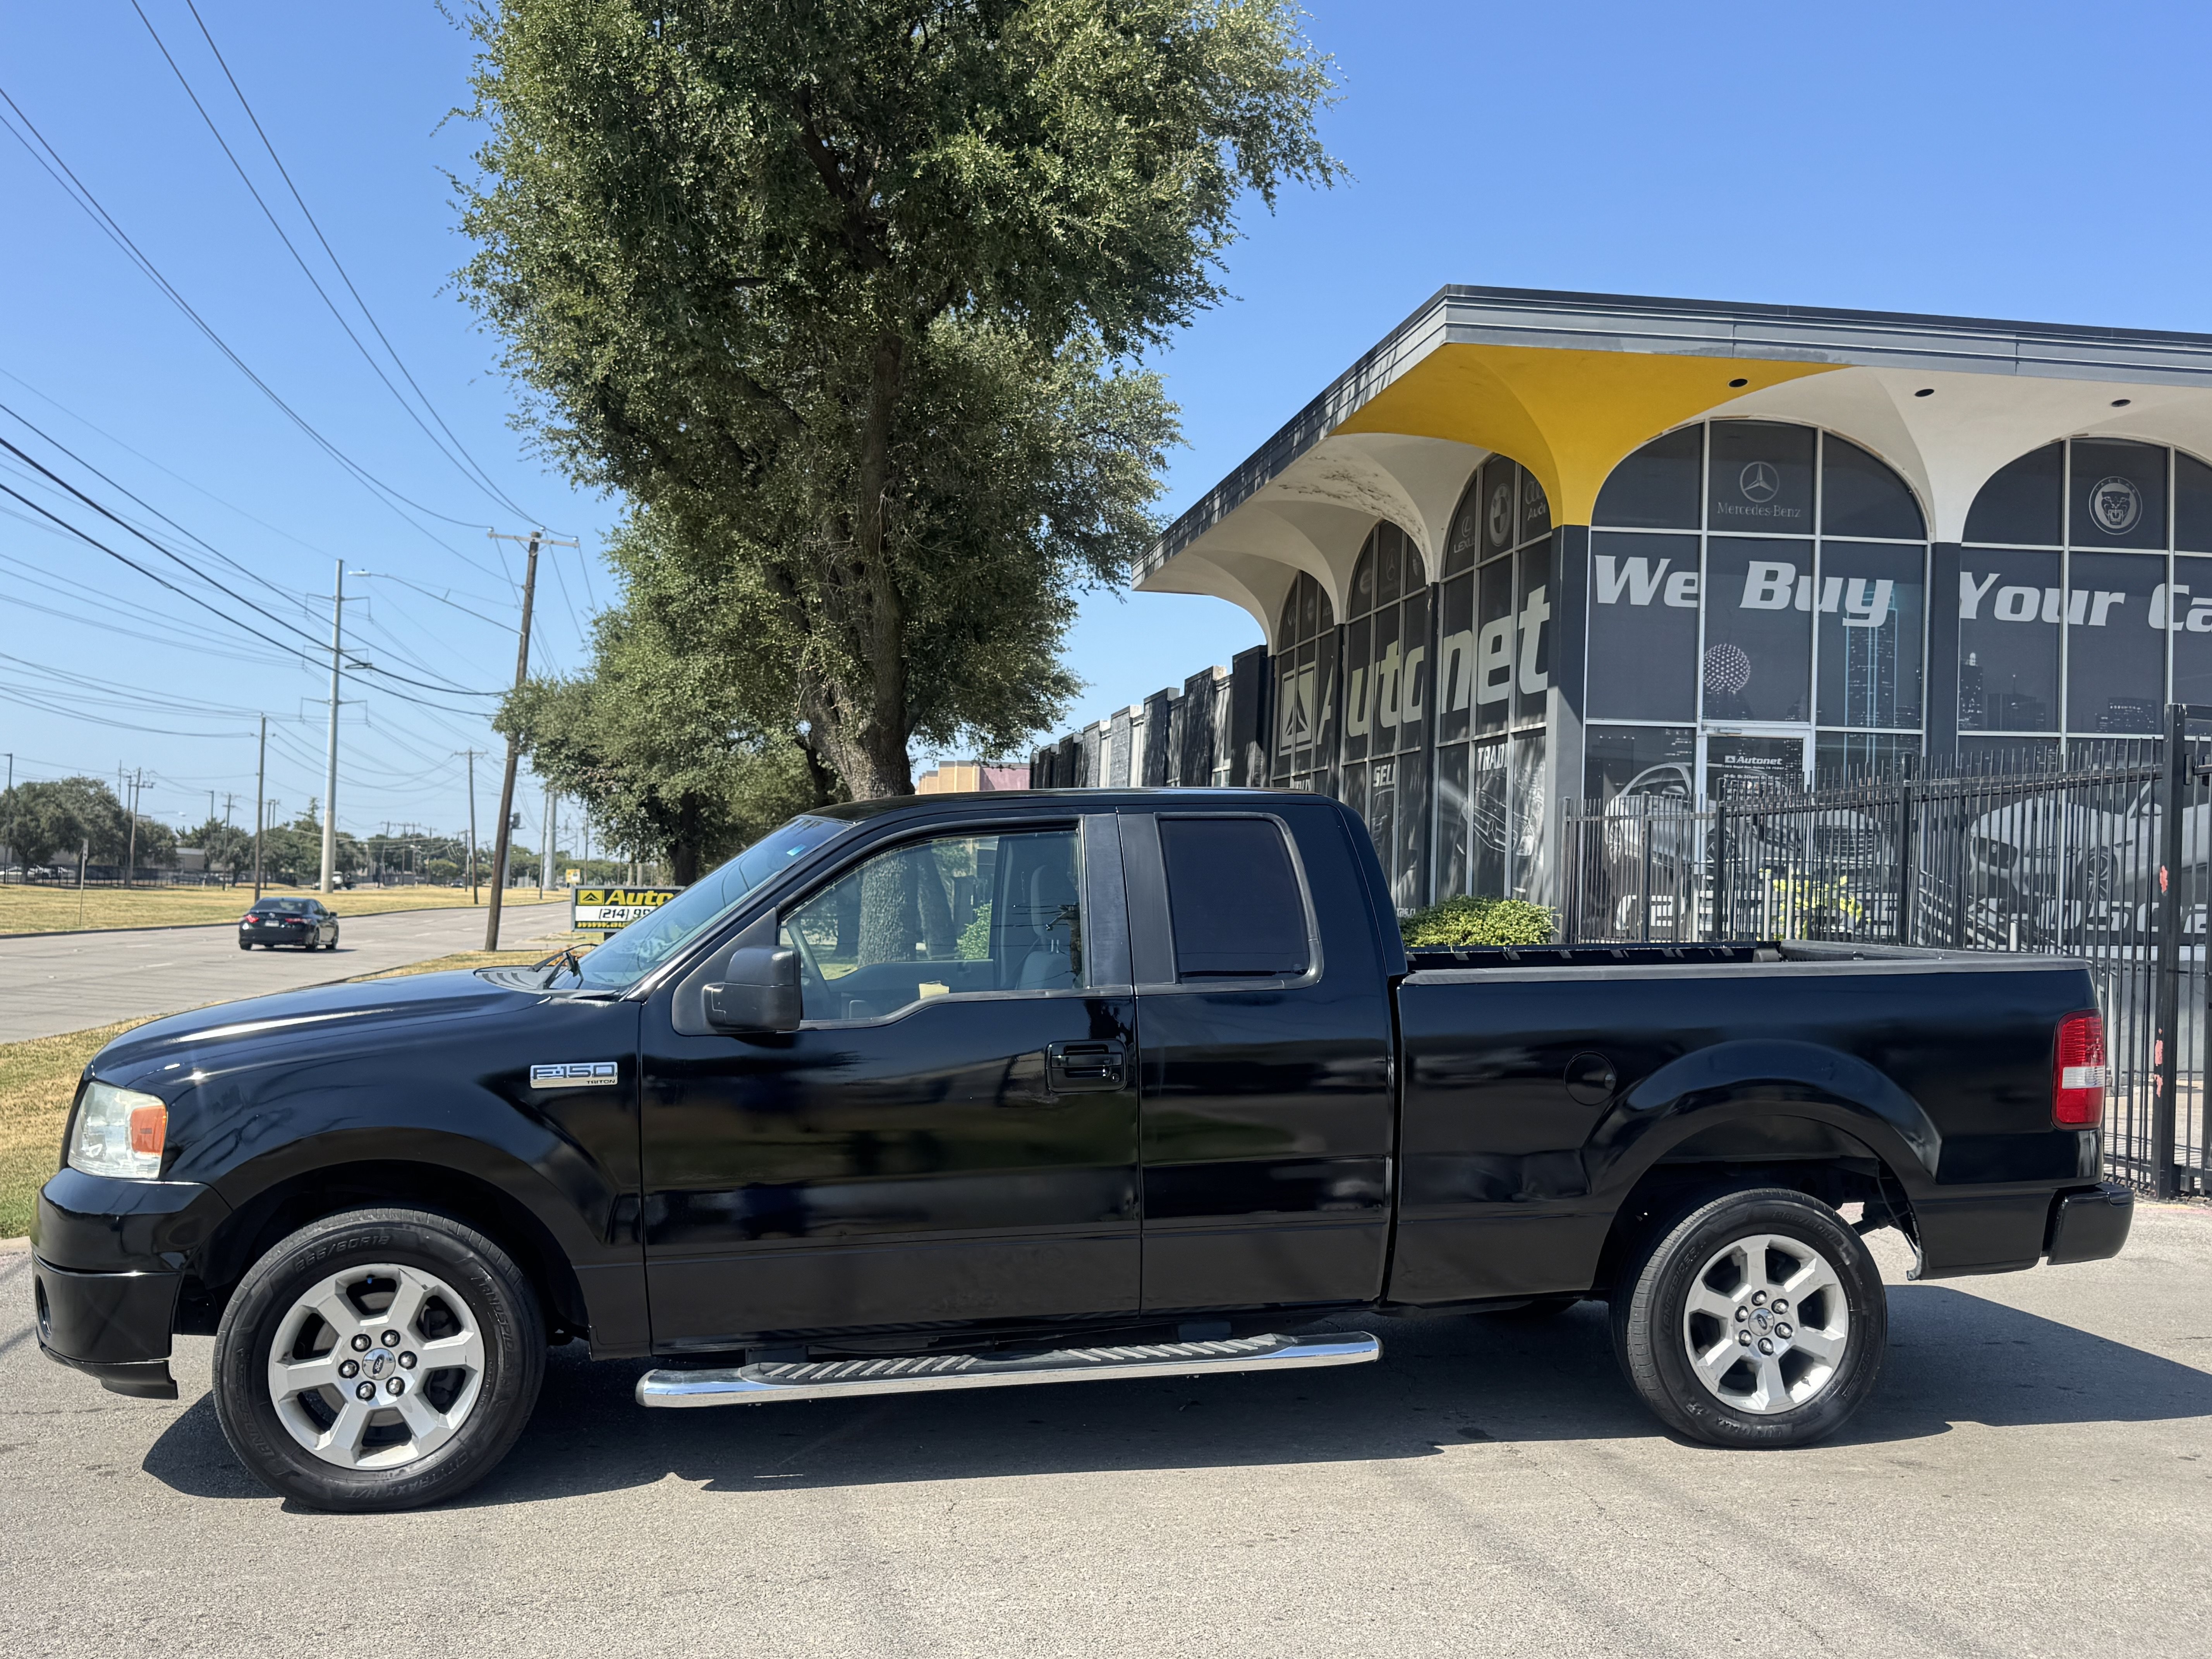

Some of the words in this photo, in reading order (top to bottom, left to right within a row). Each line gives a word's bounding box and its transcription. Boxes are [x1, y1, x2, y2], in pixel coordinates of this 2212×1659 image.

[1717, 502, 1801, 518] Mercedes-Benz
[1454, 536, 1476, 553] LEXU
[1595, 555, 1699, 608] We
[1739, 560, 1894, 627] Buy
[1960, 571, 2126, 626] Your
[1736, 756, 1783, 765] Autonet
[605, 889, 674, 905] Auto
[599, 908, 630, 920] (214)
[532, 1064, 616, 1079] F-150
